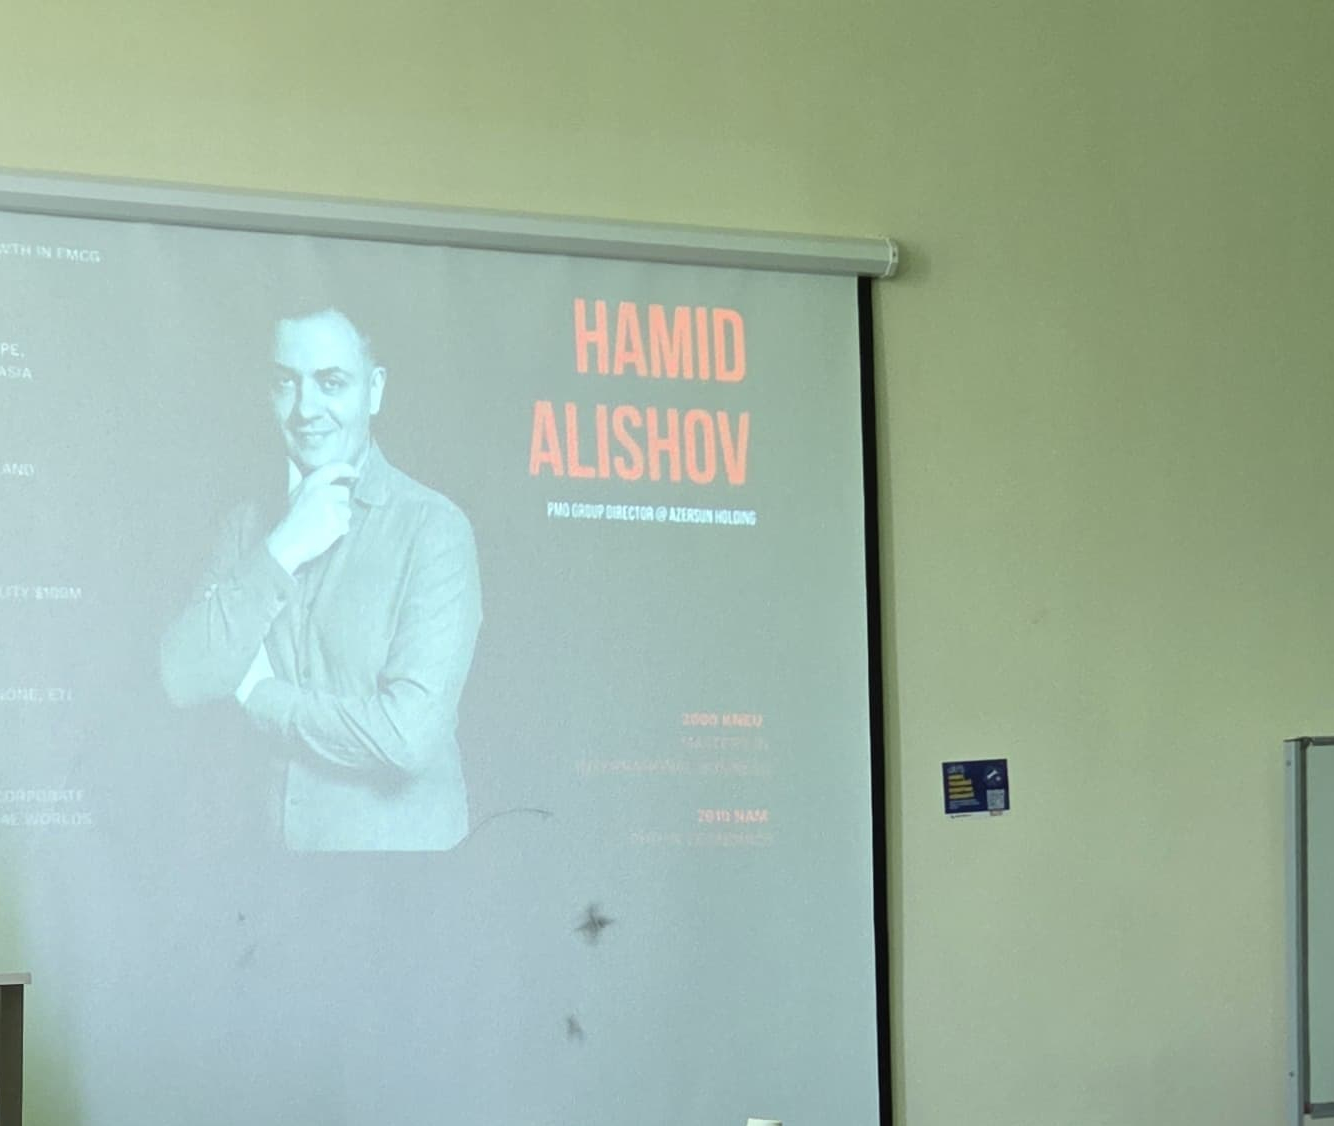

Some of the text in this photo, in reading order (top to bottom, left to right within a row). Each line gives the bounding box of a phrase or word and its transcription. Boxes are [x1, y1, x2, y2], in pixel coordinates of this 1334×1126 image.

[36, 245, 53, 259] IN
[573, 297, 747, 384] HAMID
[529, 400, 751, 485] ALISHOV
[2, 463, 35, 477] AND
[571, 502, 605, 519] GROUP
[606, 504, 654, 521] DIRECTOR
[655, 505, 668, 523] @
[669, 506, 713, 524] AZERSUN
[714, 508, 757, 526] HOLDING
